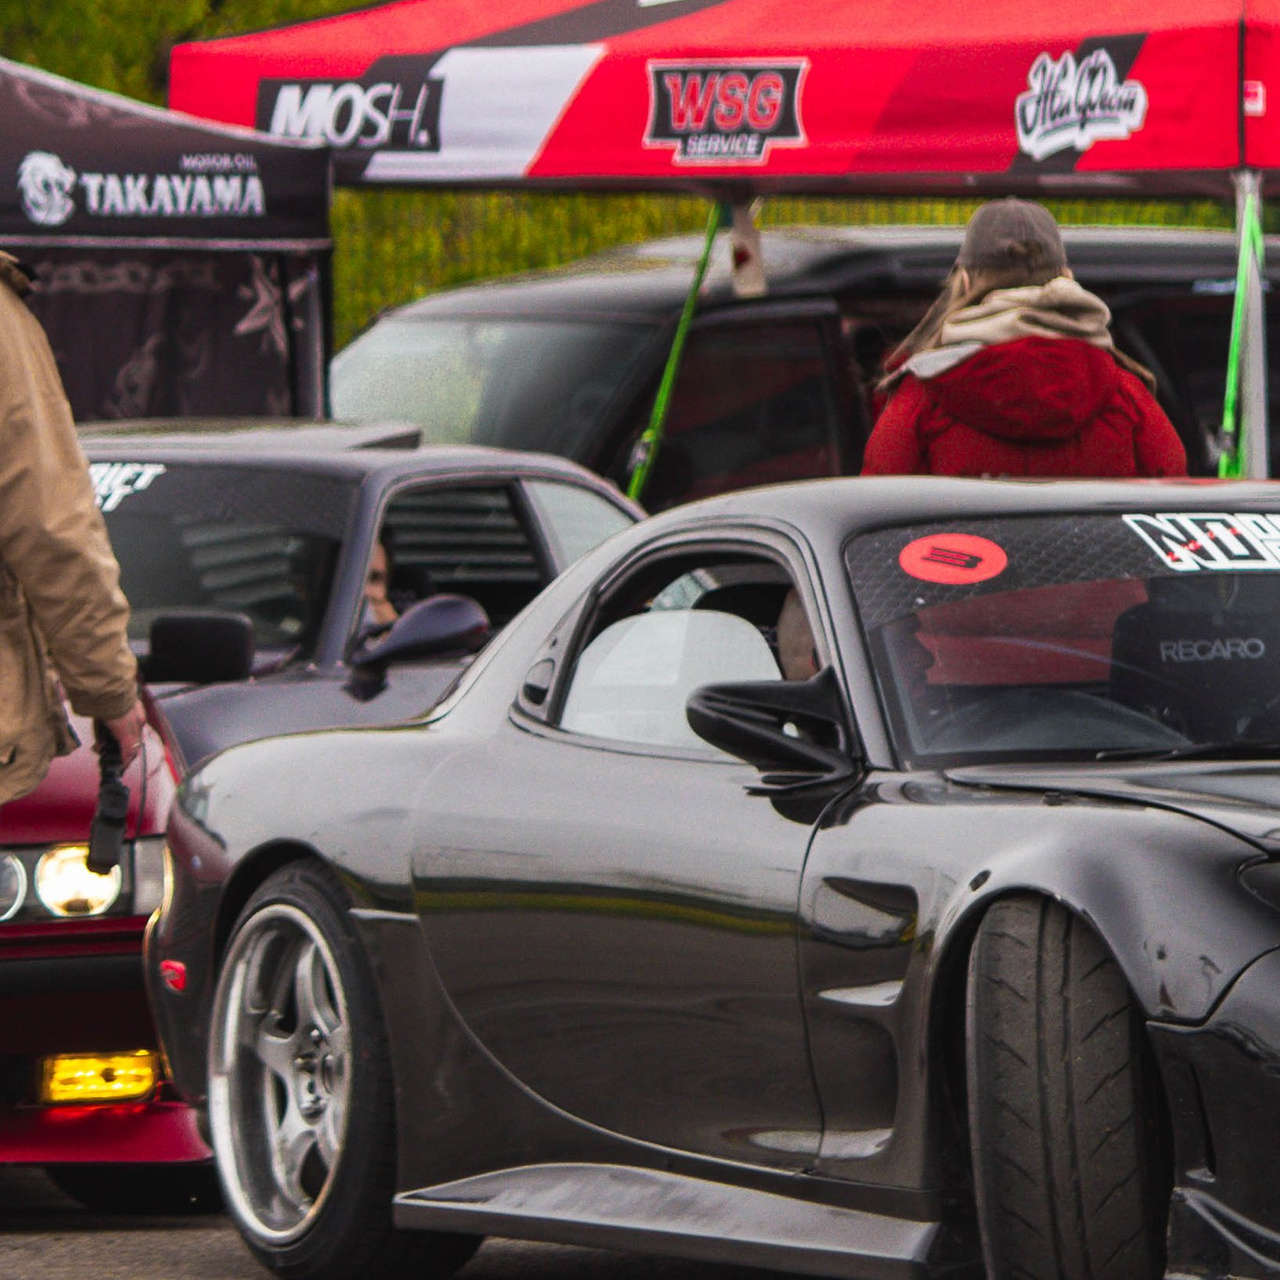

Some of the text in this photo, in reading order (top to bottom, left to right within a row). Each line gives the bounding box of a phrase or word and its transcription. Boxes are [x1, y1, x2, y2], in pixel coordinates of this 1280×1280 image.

[662, 71, 785, 132] WSG
[686, 132, 761, 157] SERVICE
[80, 172, 266, 217] TAKAYAMA
[1160, 637, 1266, 662] RECARO
